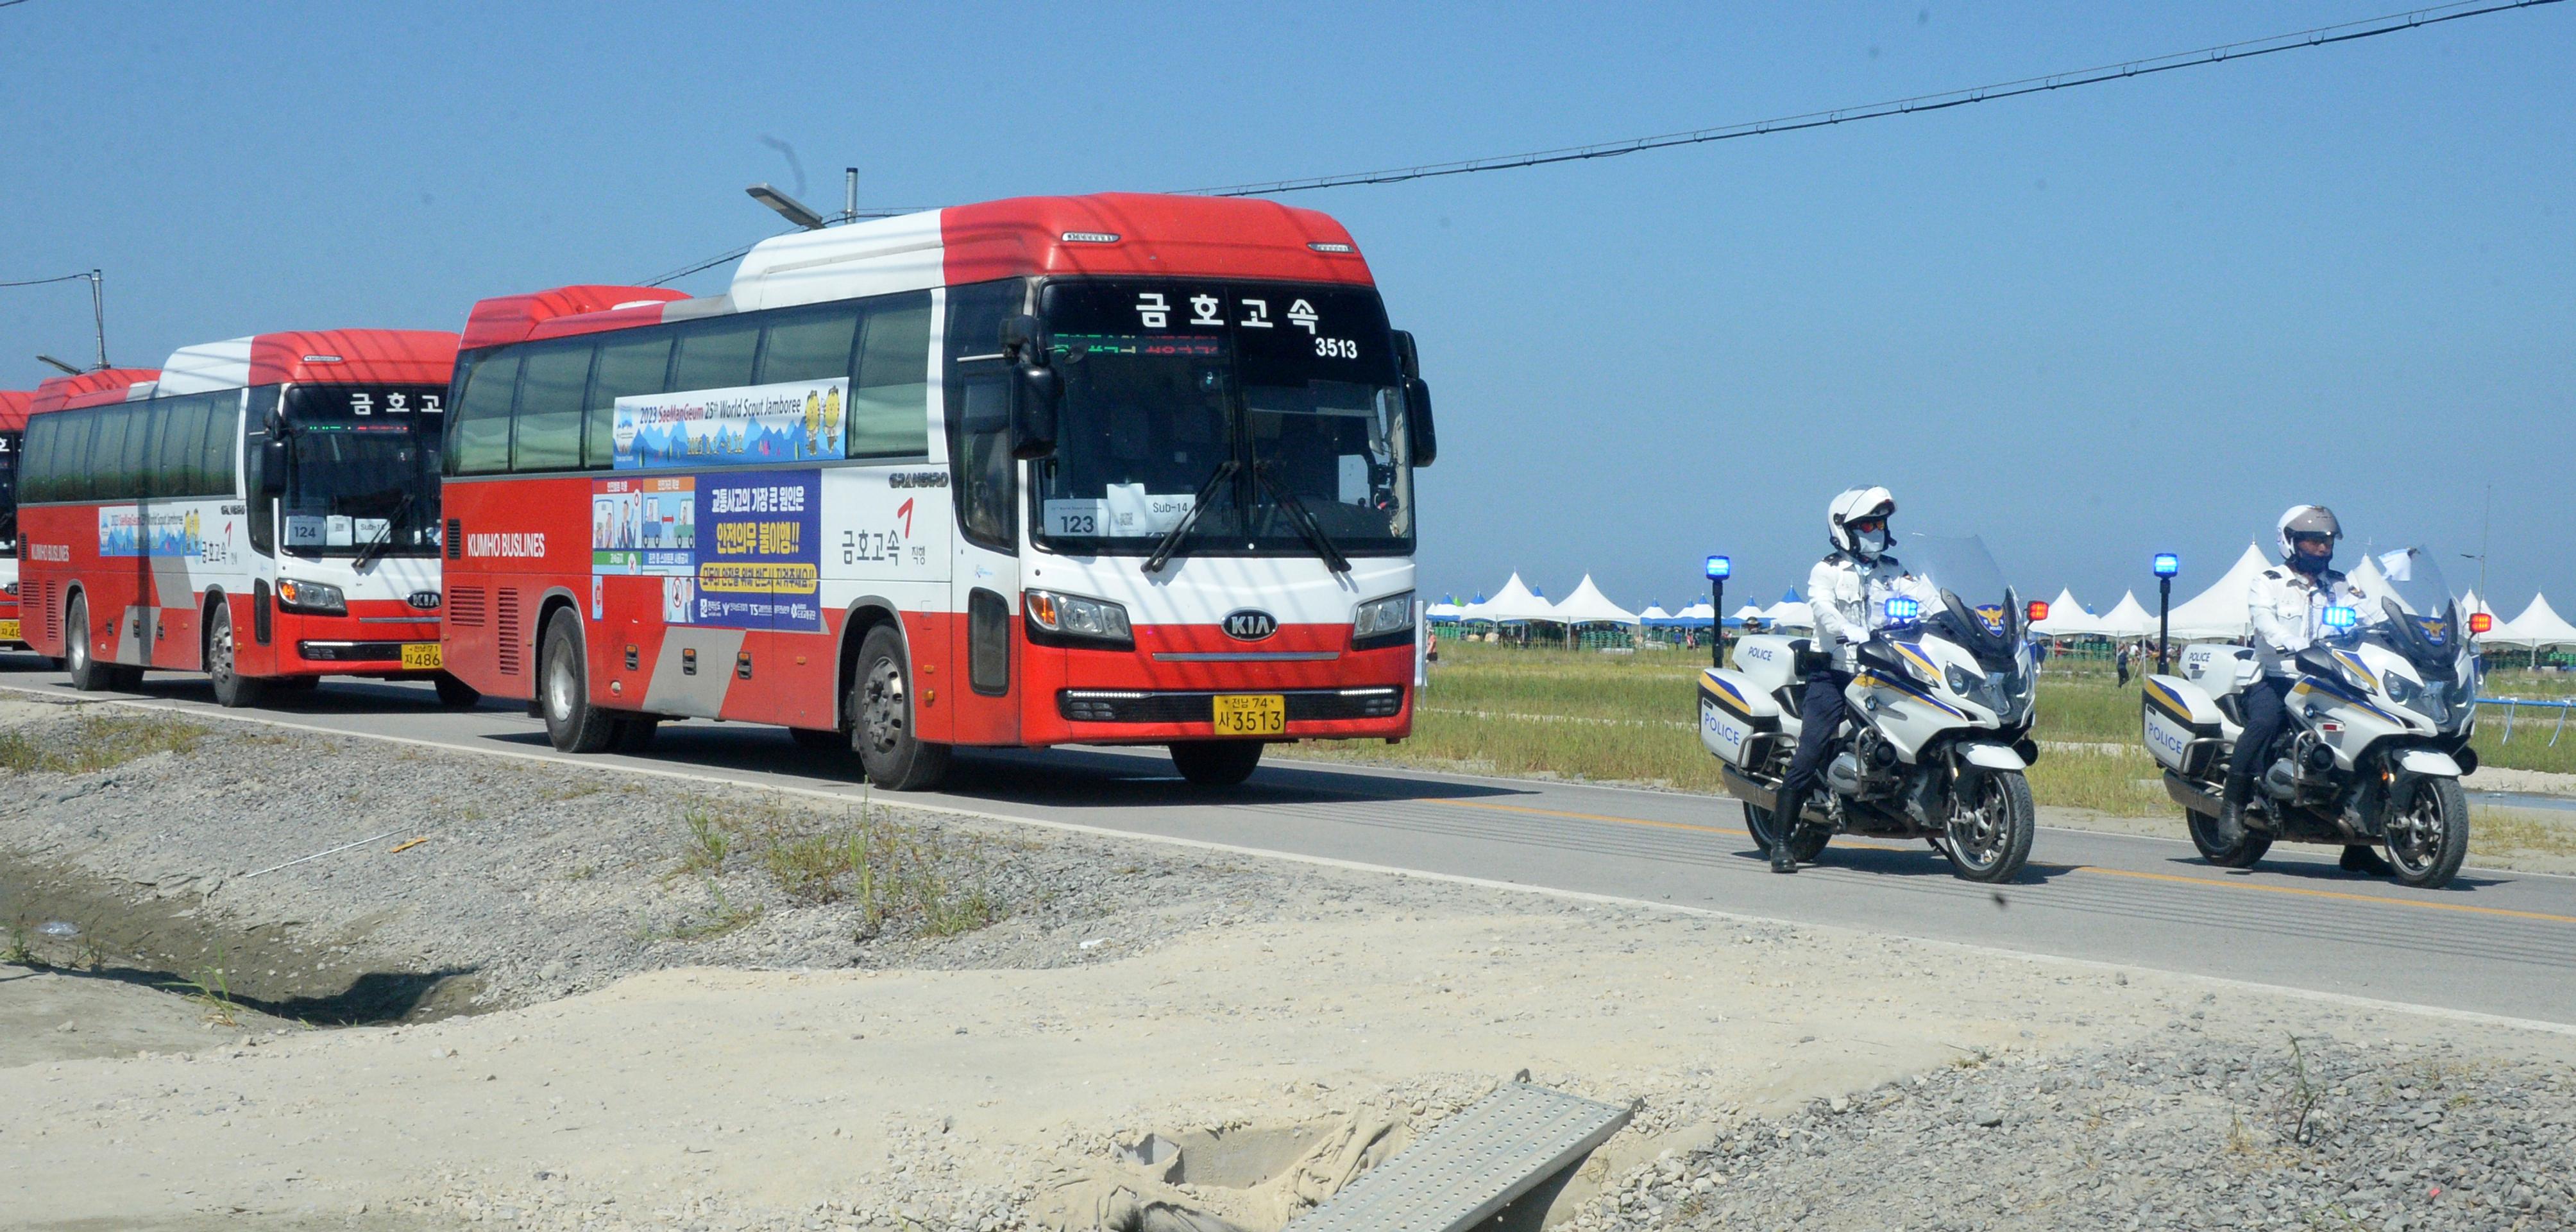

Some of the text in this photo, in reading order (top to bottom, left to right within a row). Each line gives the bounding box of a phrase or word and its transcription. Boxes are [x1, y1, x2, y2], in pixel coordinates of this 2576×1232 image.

[1136, 293, 1319, 334] 금호고속
[1316, 338, 1358, 359] 3513
[640, 395, 801, 424] 2023 SaeManGeum 25th World Scout Jamboree
[712, 486, 804, 513] 교통사고의 가장 큰 원인은
[1153, 502, 1188, 513] Sub-14
[294, 527, 316, 538] 124
[1060, 515, 1094, 533] 123
[468, 533, 545, 558] KUMHO BUSLINES
[716, 522, 800, 554] 안전의무 불이행!!
[842, 529, 900, 566] 금호고속
[201, 541, 226, 565] 금호고속
[412, 594, 440, 606] KIA
[749, 604, 758, 615] TS
[1231, 616, 1270, 634] KIA
[1749, 646, 1773, 661] POLICE
[2189, 652, 2211, 662] POLICE
[1232, 698, 1267, 708] 전남 74
[1705, 712, 1740, 746] POLICE
[2149, 723, 2182, 755] POLICE
